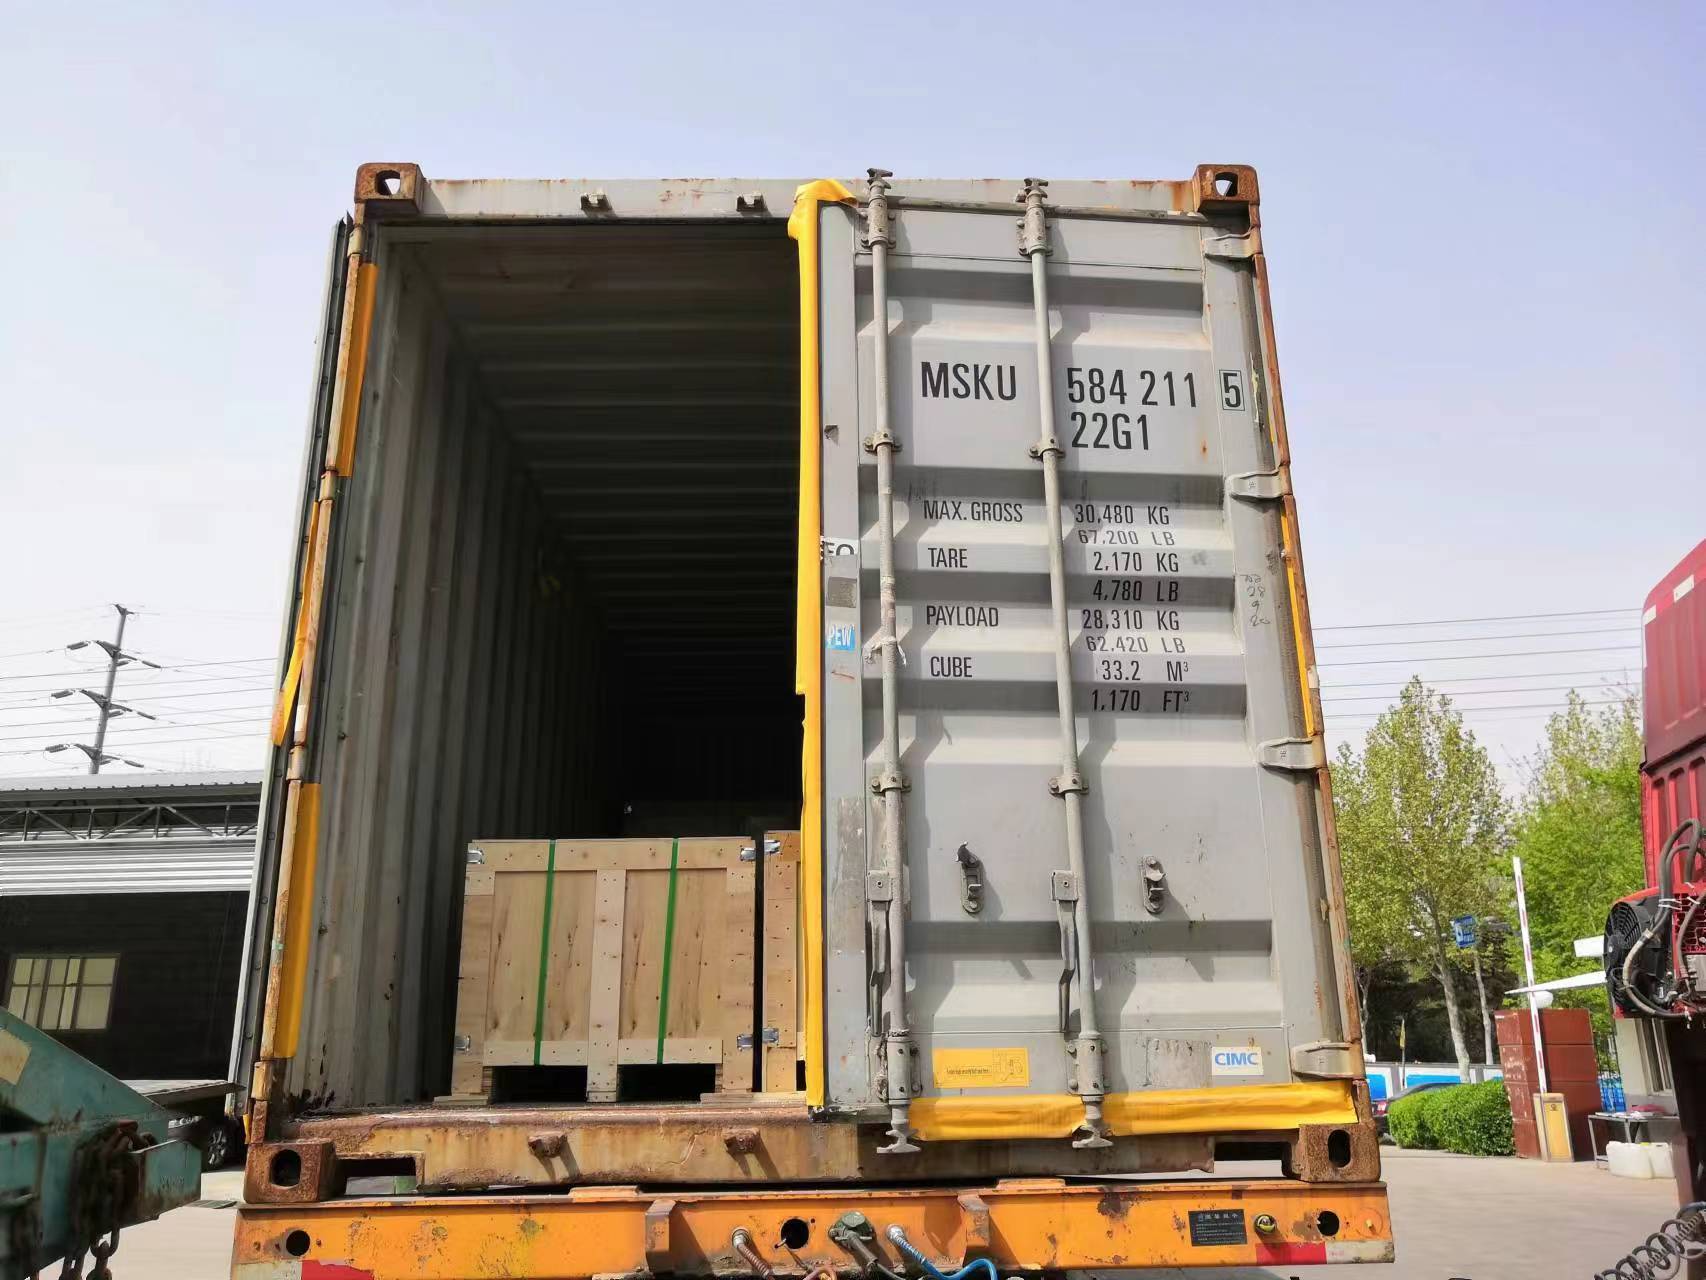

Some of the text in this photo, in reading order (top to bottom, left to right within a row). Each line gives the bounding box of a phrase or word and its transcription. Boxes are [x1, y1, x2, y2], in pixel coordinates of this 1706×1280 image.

[921, 361, 1242, 408] MSKU 584 211 5
[1070, 411, 1149, 450] 22G1
[1074, 503, 1134, 524] 30,480
[1147, 505, 1170, 525] KG
[1150, 531, 1175, 546] LB
[927, 547, 1179, 573] TARE 2,170 KG
[1092, 579, 1179, 602] 4,780 LB
[926, 605, 1180, 631] PAYLOAD 28,310 KG
[1160, 637, 1186, 653] LB
[930, 656, 973, 678] CUBE
[1101, 660, 1141, 681] 33.2
[1092, 689, 1140, 711] 1,170
[1215, 1052, 1258, 1066] CIMC
